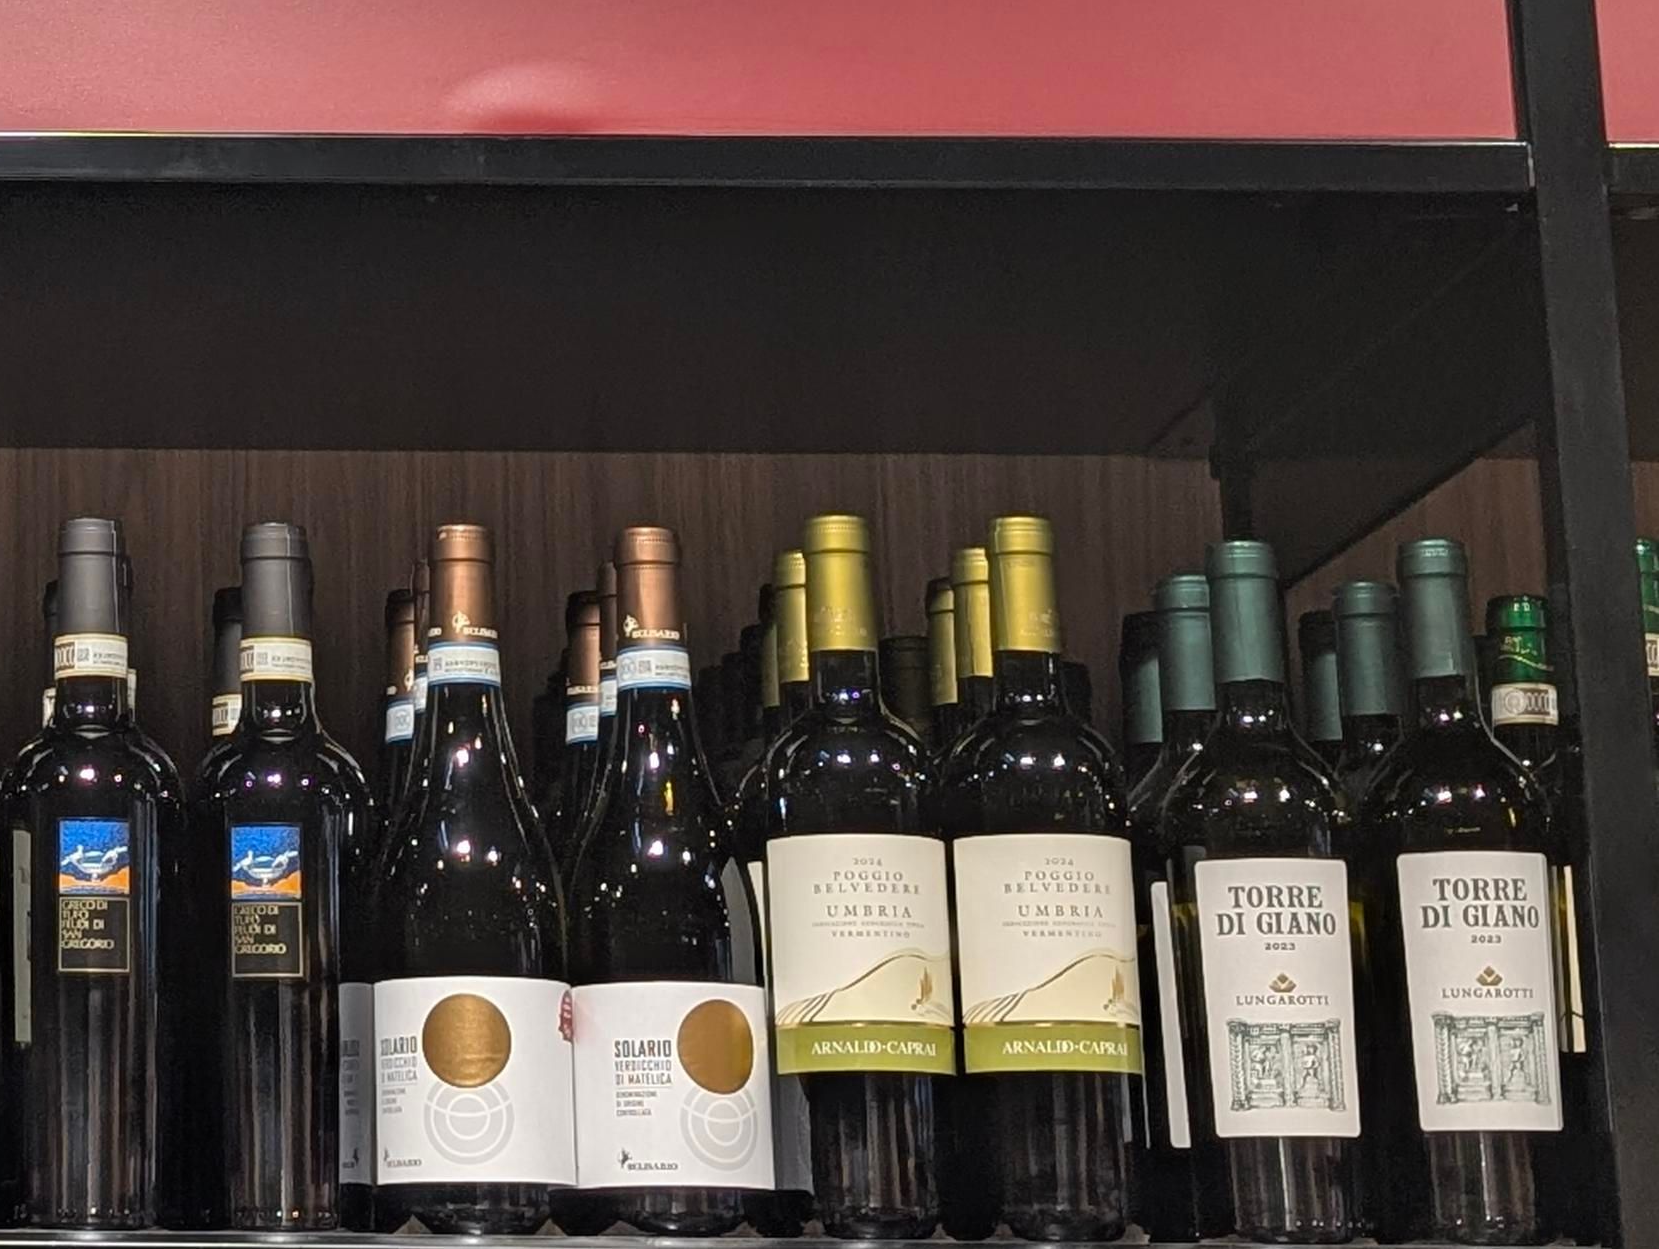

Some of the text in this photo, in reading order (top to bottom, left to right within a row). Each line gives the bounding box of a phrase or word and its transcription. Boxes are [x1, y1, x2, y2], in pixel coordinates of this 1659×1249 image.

[852, 858, 882, 866] 2024
[1044, 857, 1074, 866] 2024
[834, 871, 903, 882] POGGIO
[1024, 871, 1094, 882] POGGIO
[1432, 878, 1527, 901] TORRE
[1228, 885, 1323, 909] TORRE
[827, 905, 912, 918] UMBRIA
[1018, 905, 1103, 918] UMBRIA
[1420, 904, 1540, 929] DI GIANO
[1216, 912, 1336, 936] DI GIANO
[1471, 934, 1502, 943] 2023
[1264, 942, 1296, 951] 2023
[1442, 988, 1534, 999] LUNGAROTTI
[1236, 995, 1329, 1006] LUNGAROTTI
[614, 1040, 672, 1058] SOLARIO
[628, 1073, 672, 1085] MATELICA
